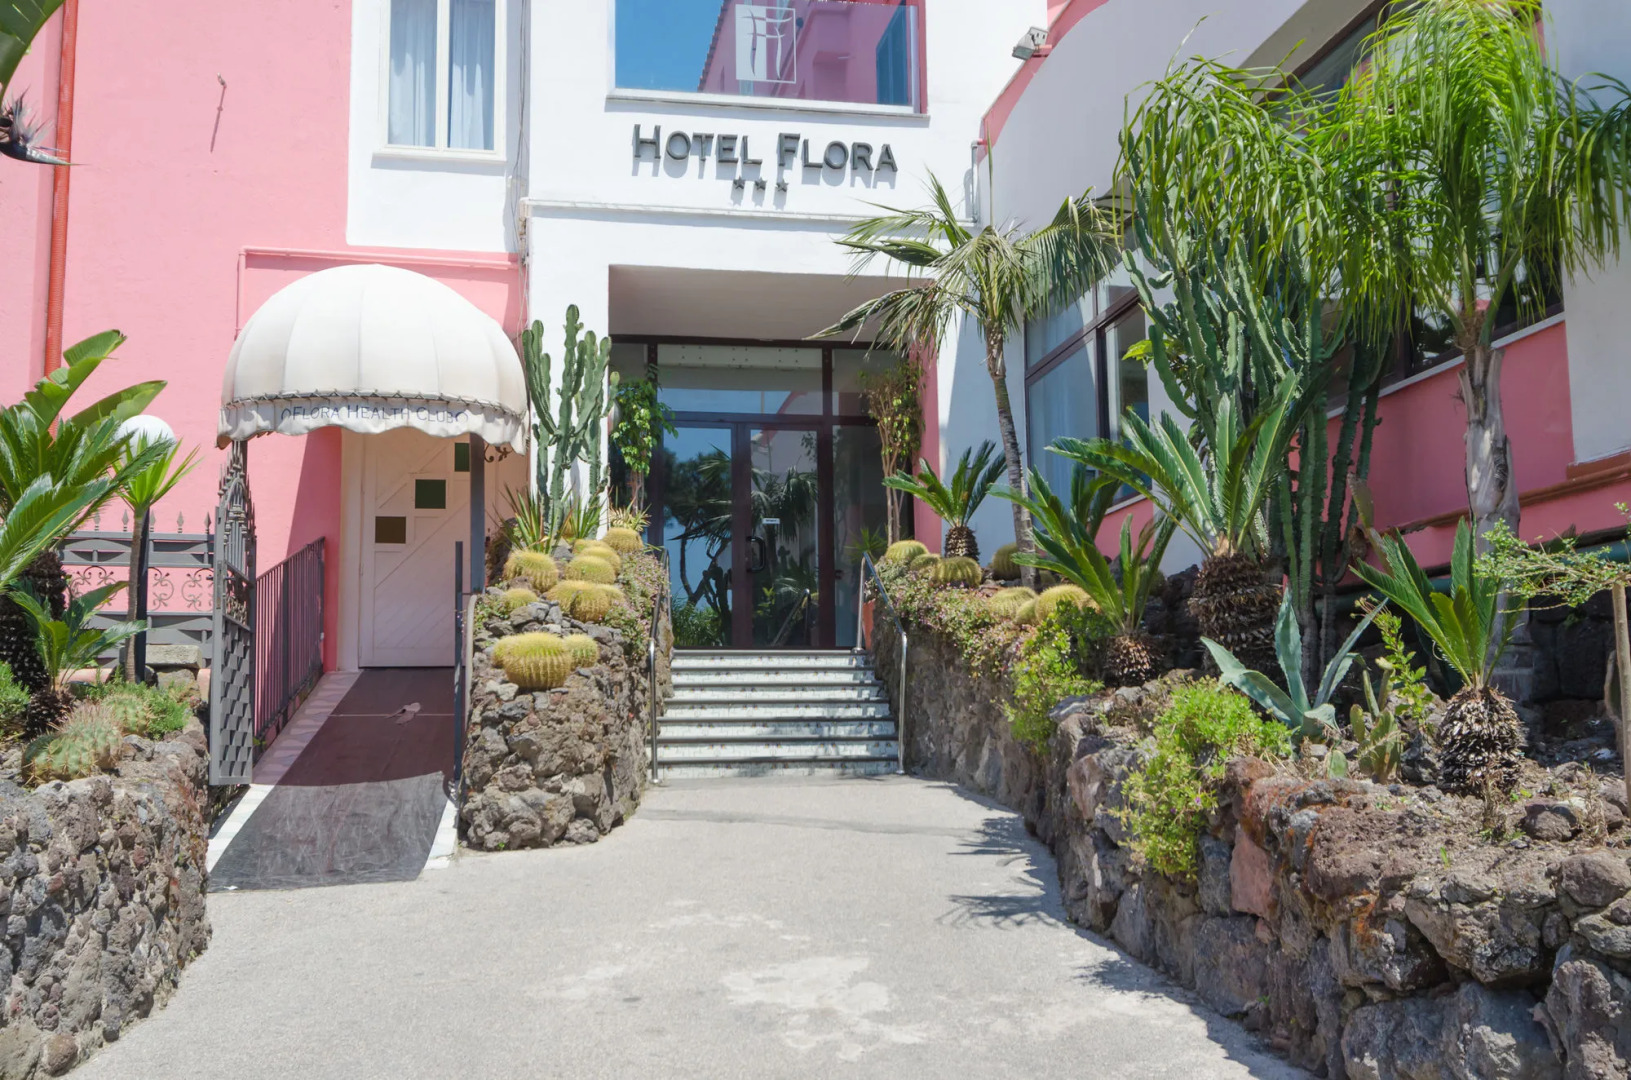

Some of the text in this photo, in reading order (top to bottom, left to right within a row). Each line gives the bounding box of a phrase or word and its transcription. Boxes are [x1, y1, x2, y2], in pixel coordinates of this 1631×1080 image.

[633, 123, 898, 173] HOTEL FLORA
[293, 404, 453, 424] FLORA HEALTH CLUB
